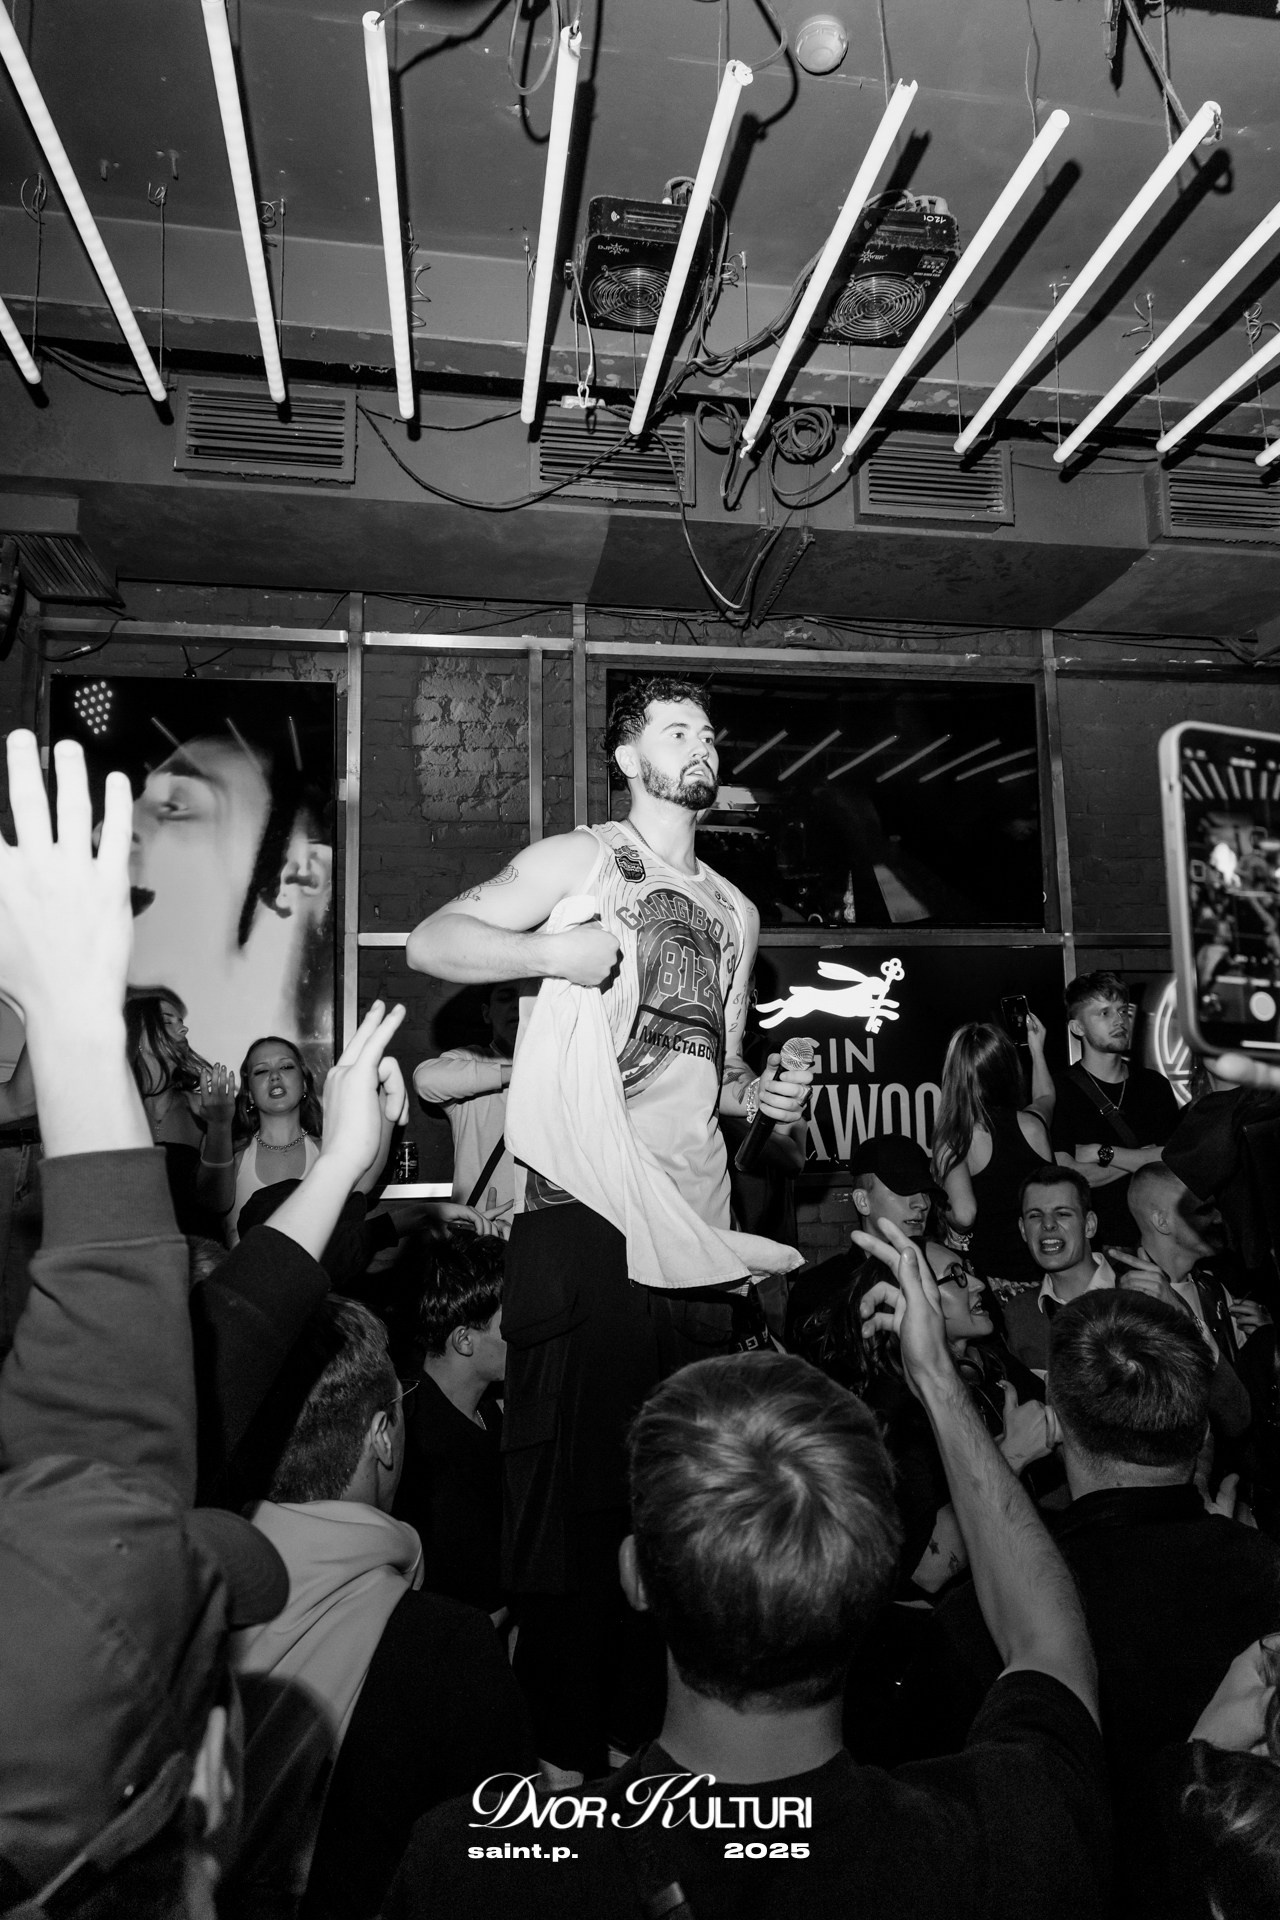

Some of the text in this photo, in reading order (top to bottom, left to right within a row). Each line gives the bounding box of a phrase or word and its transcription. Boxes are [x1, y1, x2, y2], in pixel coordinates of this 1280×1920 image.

[923, 214, 947, 225] 1201
[657, 940, 717, 1012] 812
[805, 1082, 942, 1160] KWOO
